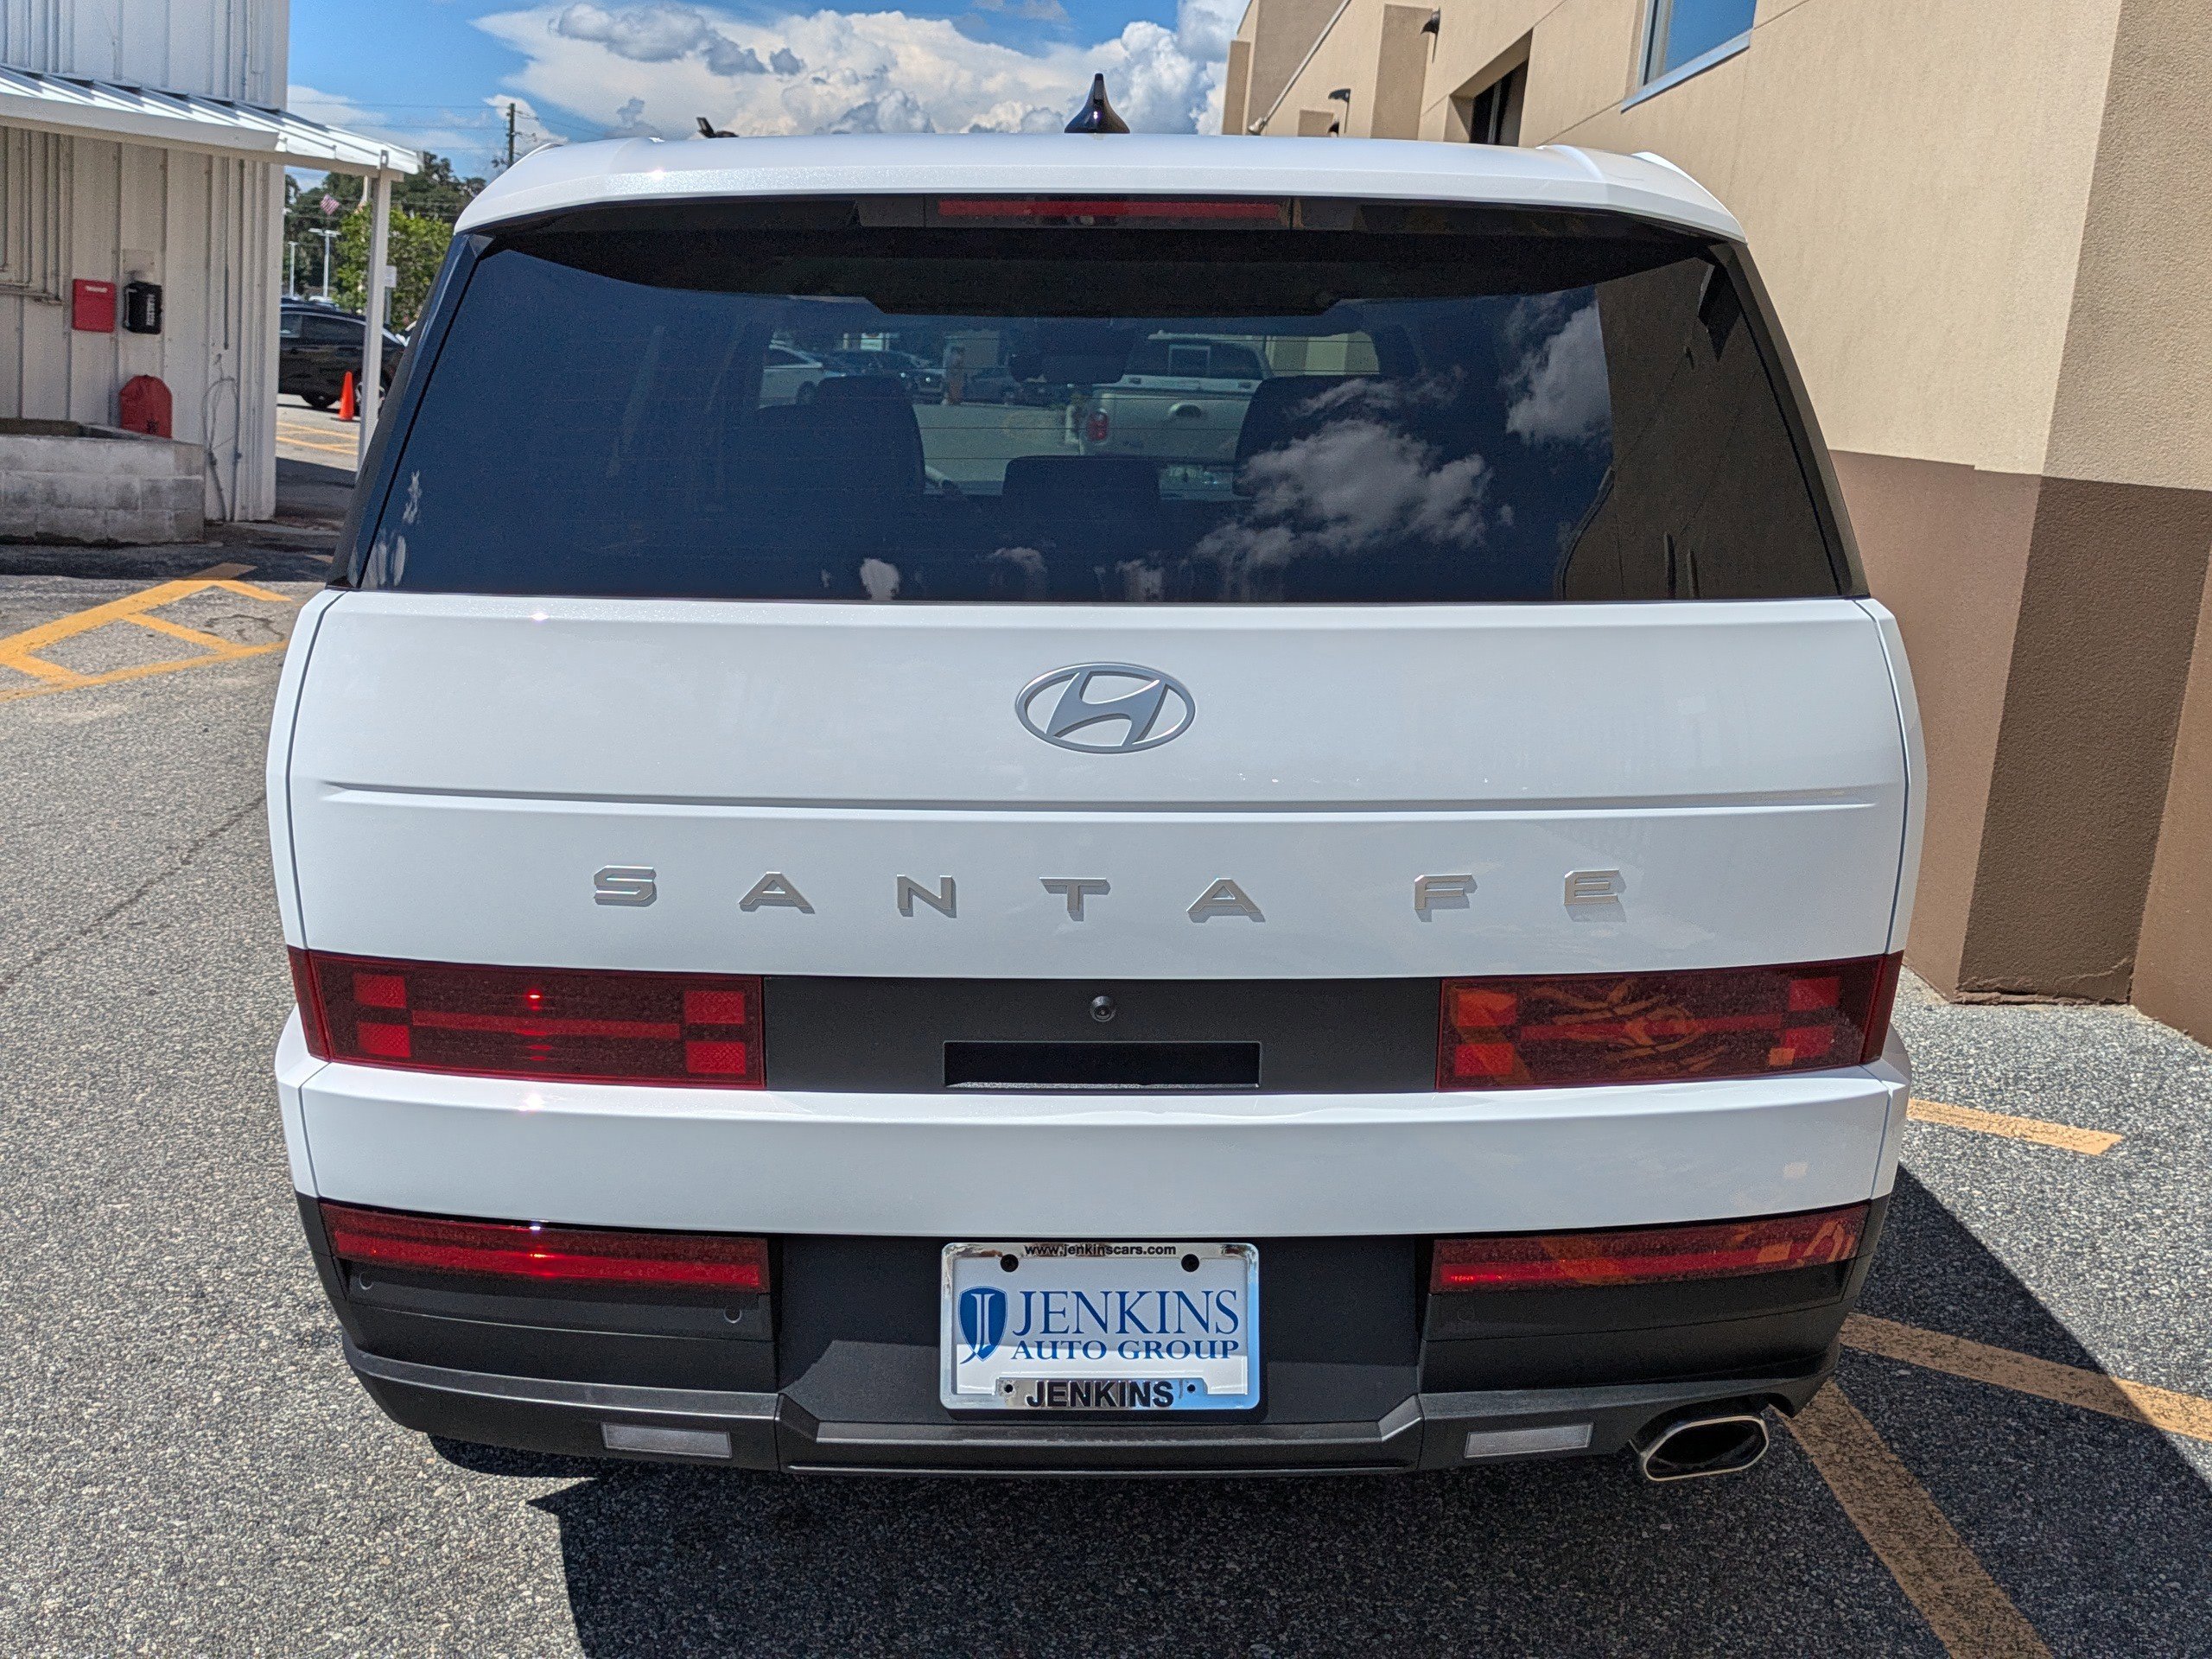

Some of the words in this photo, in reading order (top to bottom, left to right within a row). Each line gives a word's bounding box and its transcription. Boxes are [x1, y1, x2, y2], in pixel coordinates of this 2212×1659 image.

[594, 864, 1262, 919] SANTA
[1414, 868, 1623, 918] FE
[1025, 1244, 1177, 1256] www.jenkinscars.com
[1012, 1289, 1239, 1337] JENKINS
[1010, 1339, 1107, 1360] AUTO
[1117, 1339, 1239, 1360] GROUP
[1026, 1380, 1174, 1408] JENKINS
